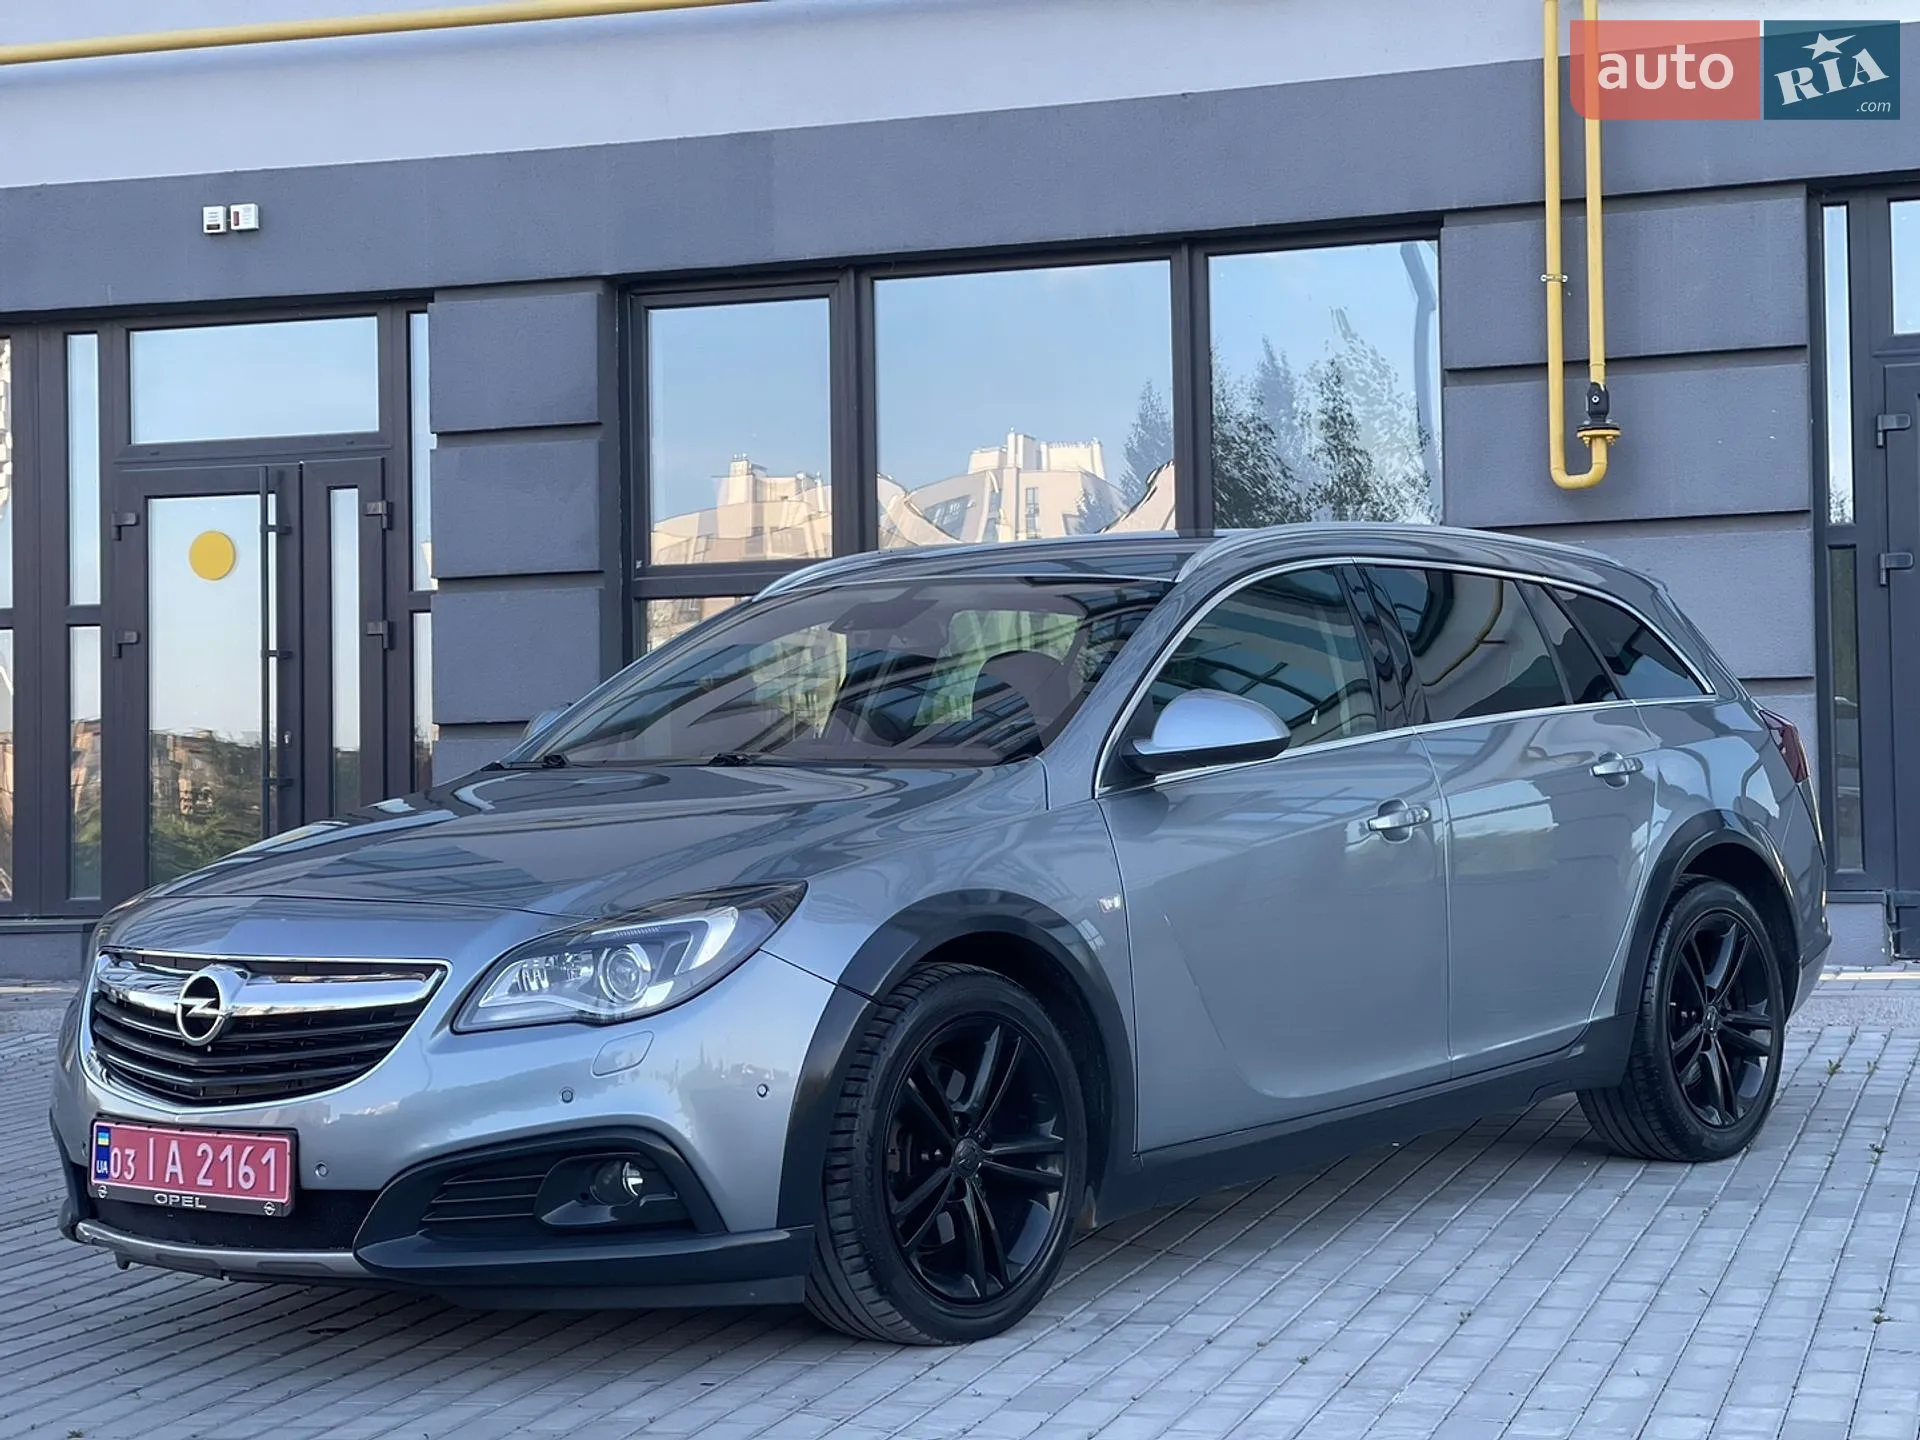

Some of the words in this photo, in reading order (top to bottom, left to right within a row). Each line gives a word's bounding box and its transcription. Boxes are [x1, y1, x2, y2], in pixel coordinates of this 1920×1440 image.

[96, 1160, 108, 1174] UA
[111, 1148, 136, 1180] 03
[196, 1142, 277, 1192] 2161
[154, 1193, 207, 1209] OPEL
